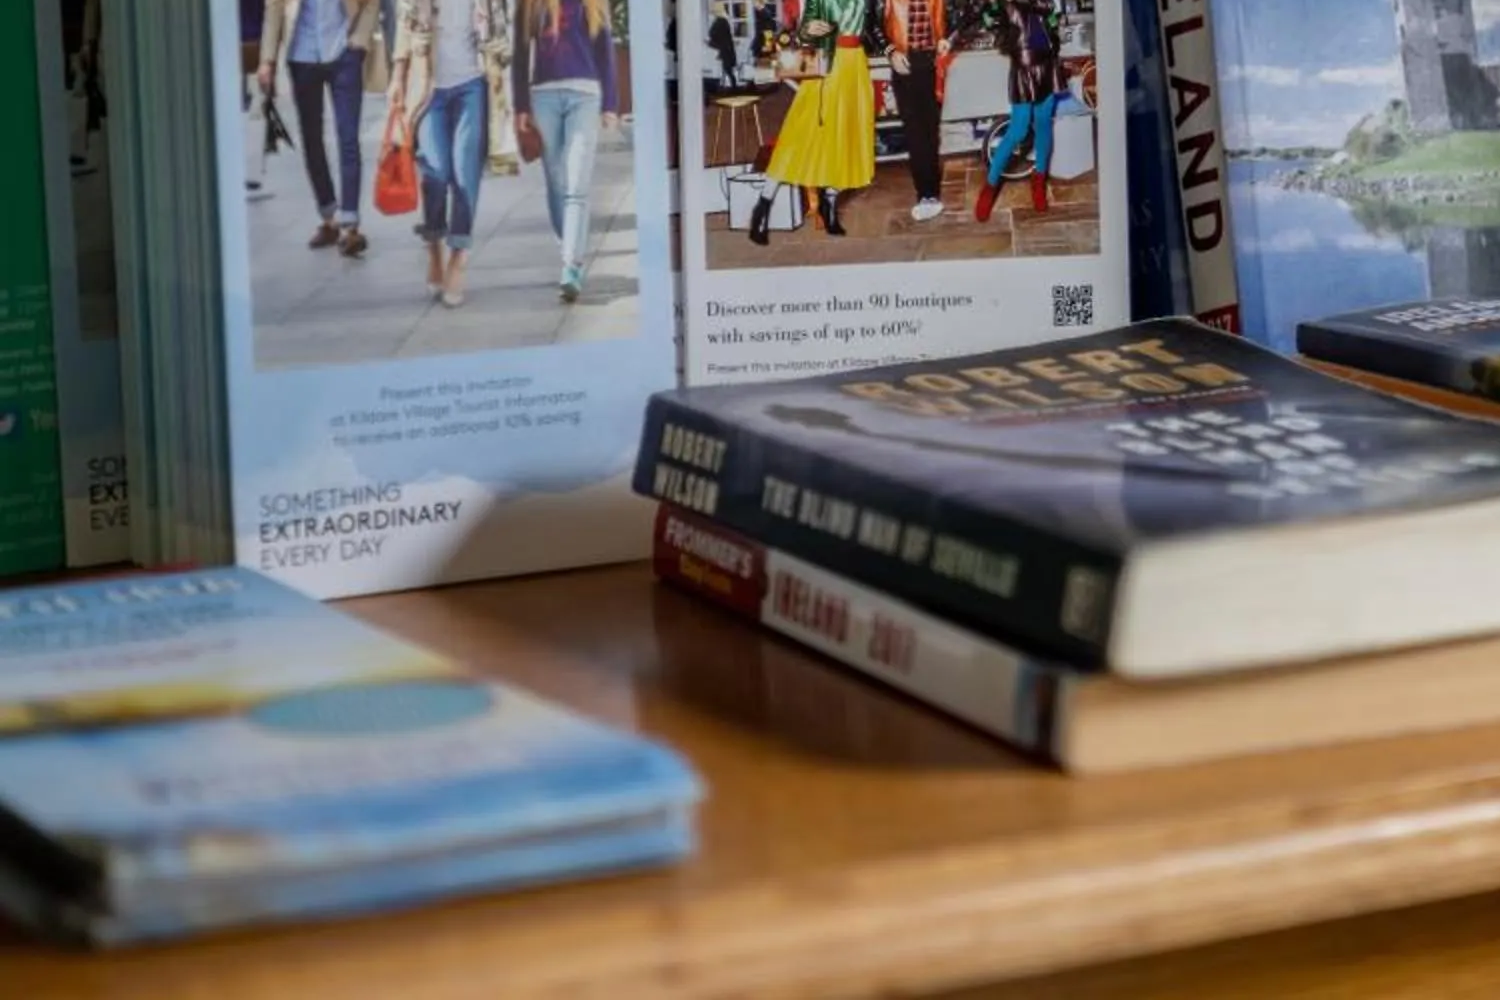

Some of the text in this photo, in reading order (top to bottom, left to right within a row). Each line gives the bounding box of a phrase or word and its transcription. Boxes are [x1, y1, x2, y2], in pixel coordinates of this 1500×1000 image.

[706, 292, 973, 316] Discover more than 90 boutiques
[707, 328, 743, 344] with
[750, 326, 808, 344] savings
[813, 323, 831, 339] of
[833, 325, 855, 344] up
[860, 323, 877, 338] to
[841, 338, 1184, 398] ROBERT
[438, 381, 463, 395] this
[350, 409, 398, 424] Kildare
[402, 404, 450, 420] Village
[660, 422, 727, 474] ROBERT
[259, 481, 401, 517] SOMETHING
[653, 463, 720, 515] WILSON
[761, 475, 798, 519] THE
[259, 501, 462, 543] EXTRAORDINARY
[260, 536, 386, 570] EVERY DAY
